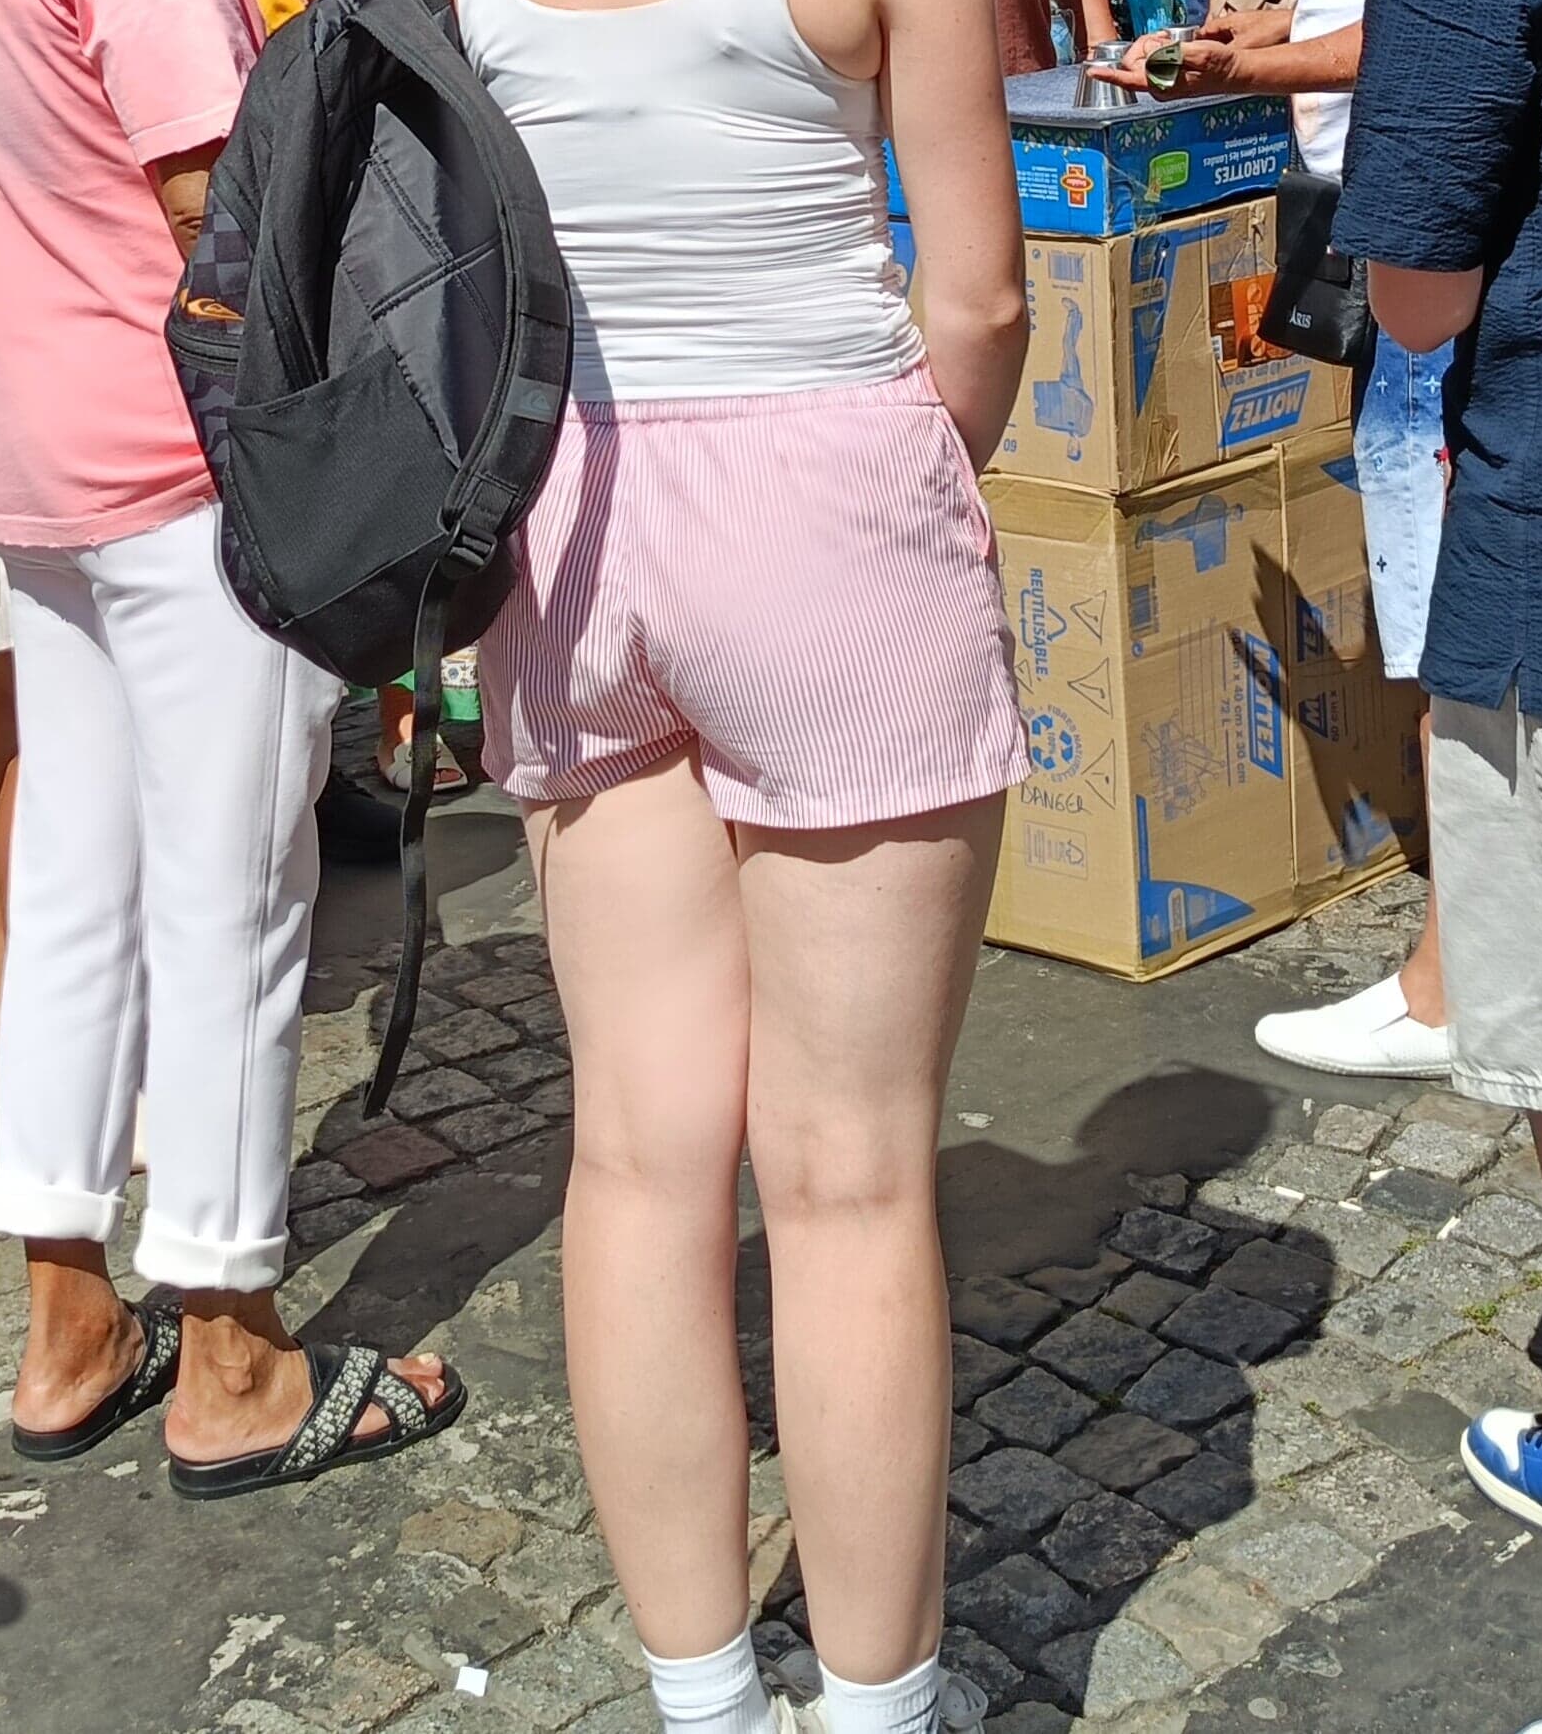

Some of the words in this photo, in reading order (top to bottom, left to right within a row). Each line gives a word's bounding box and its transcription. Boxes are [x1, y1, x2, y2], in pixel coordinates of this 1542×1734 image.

[1214, 155, 1277, 185] CAROTTES
[1229, 384, 1304, 433] MOTTEZ
[1030, 567, 1049, 676] REUTILISABLE
[1220, 698, 1231, 713] 72
[1234, 684, 1244, 702] 40
[1252, 647, 1276, 766] MOTTEZ
[1047, 704, 1077, 733] FIBRES
[1234, 704, 1243, 727] cm
[1047, 731, 1057, 755] 100%
[1236, 741, 1246, 758] 30
[1050, 733, 1083, 784] NATURELLES
[1237, 761, 1247, 784] cm
[1020, 781, 1093, 815] DANGER
